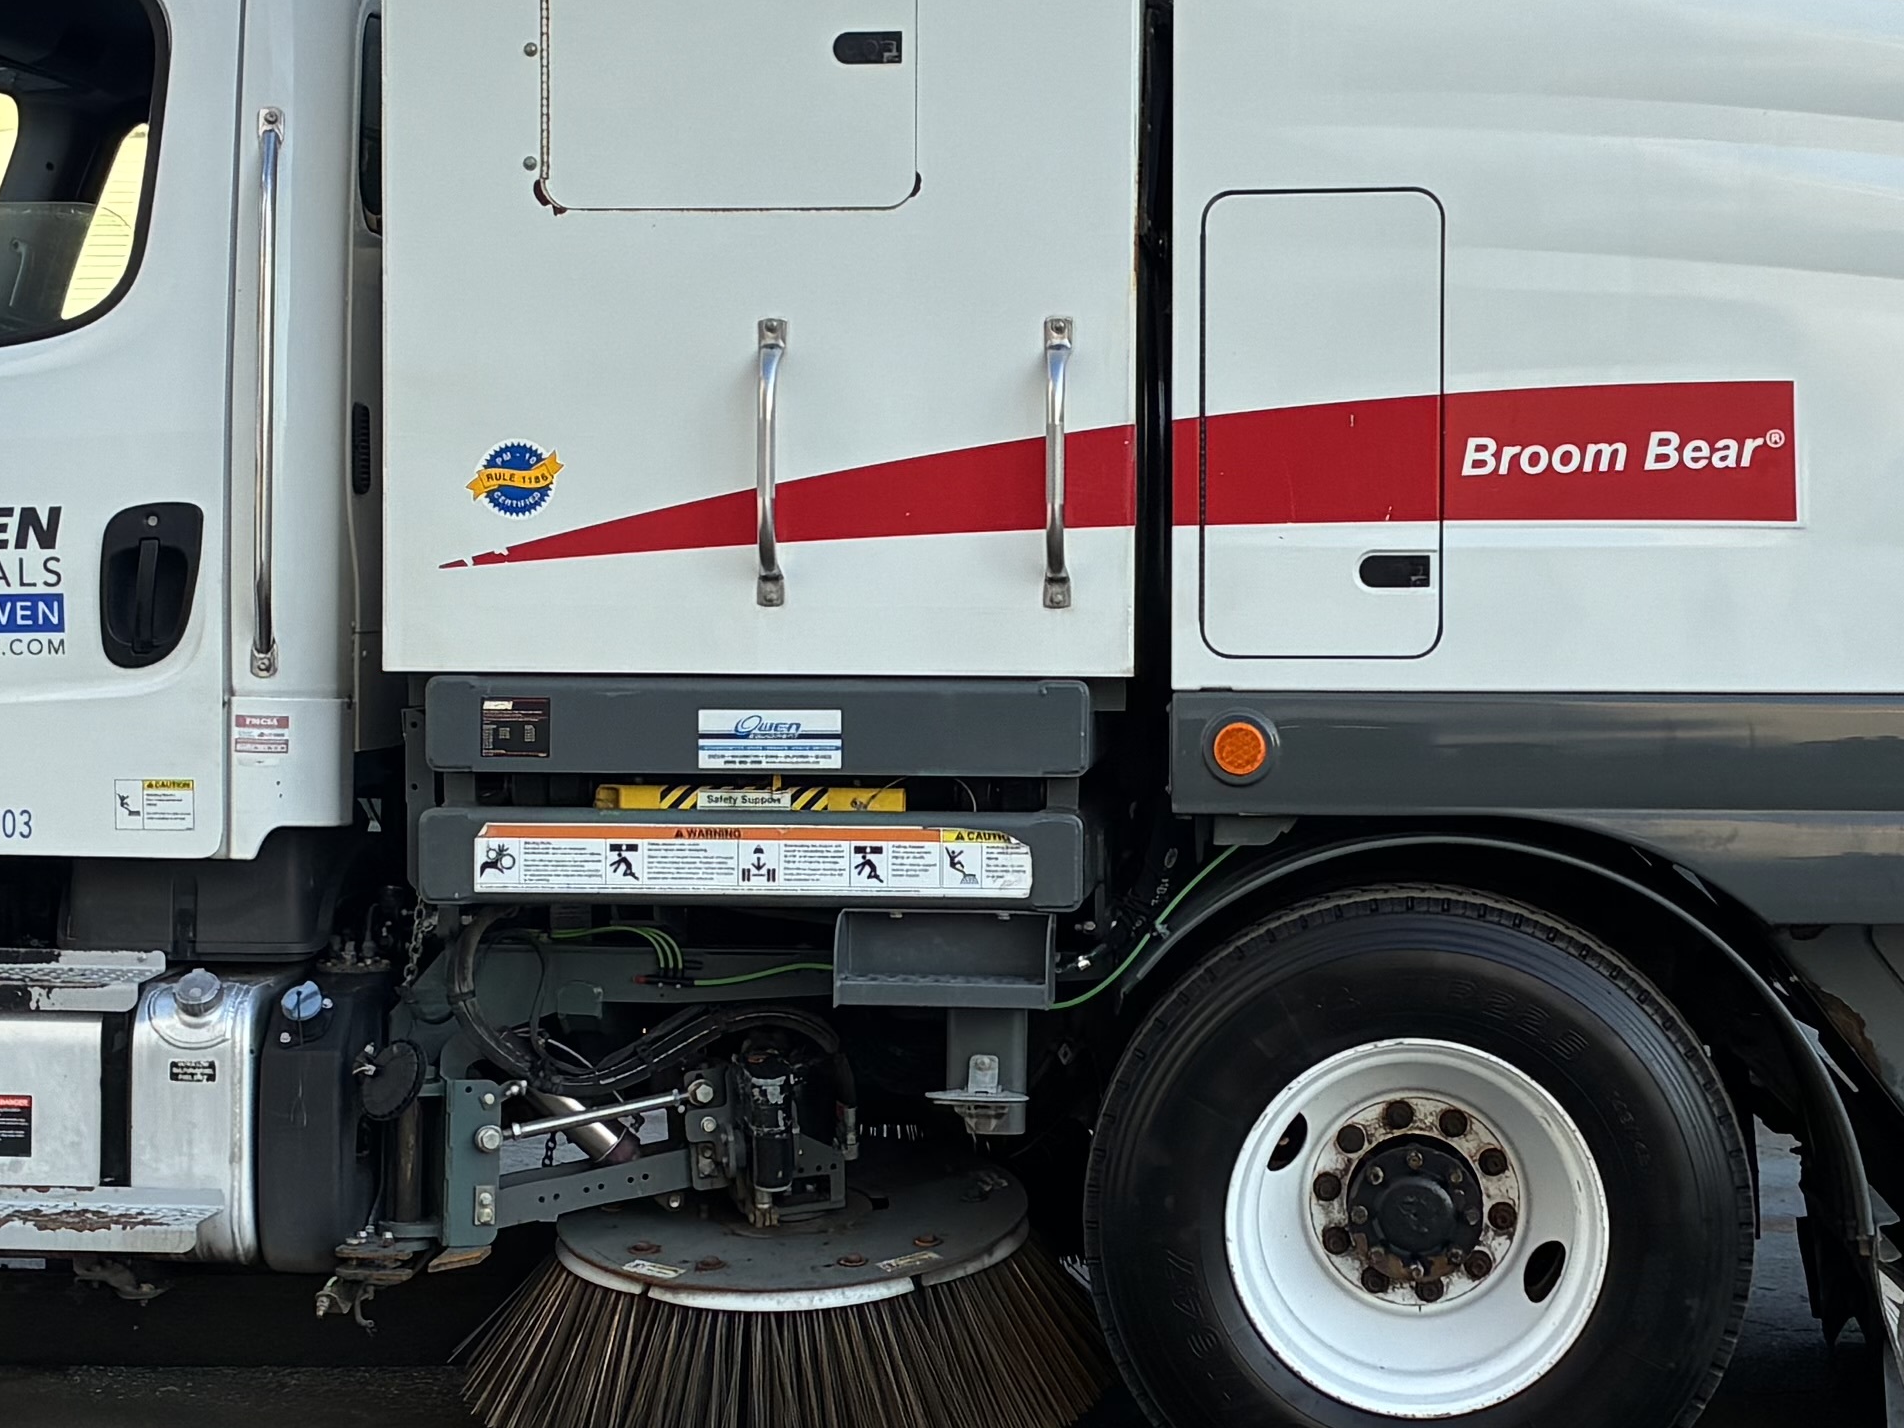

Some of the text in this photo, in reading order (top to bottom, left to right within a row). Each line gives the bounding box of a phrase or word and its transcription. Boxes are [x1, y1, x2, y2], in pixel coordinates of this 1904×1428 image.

[1461, 436, 1628, 477] Broom
[485, 472, 516, 483] RULE
[494, 491, 541, 508] CERTIFIED
[706, 794, 782, 807] Safety Support
[686, 827, 742, 840] WARNING
